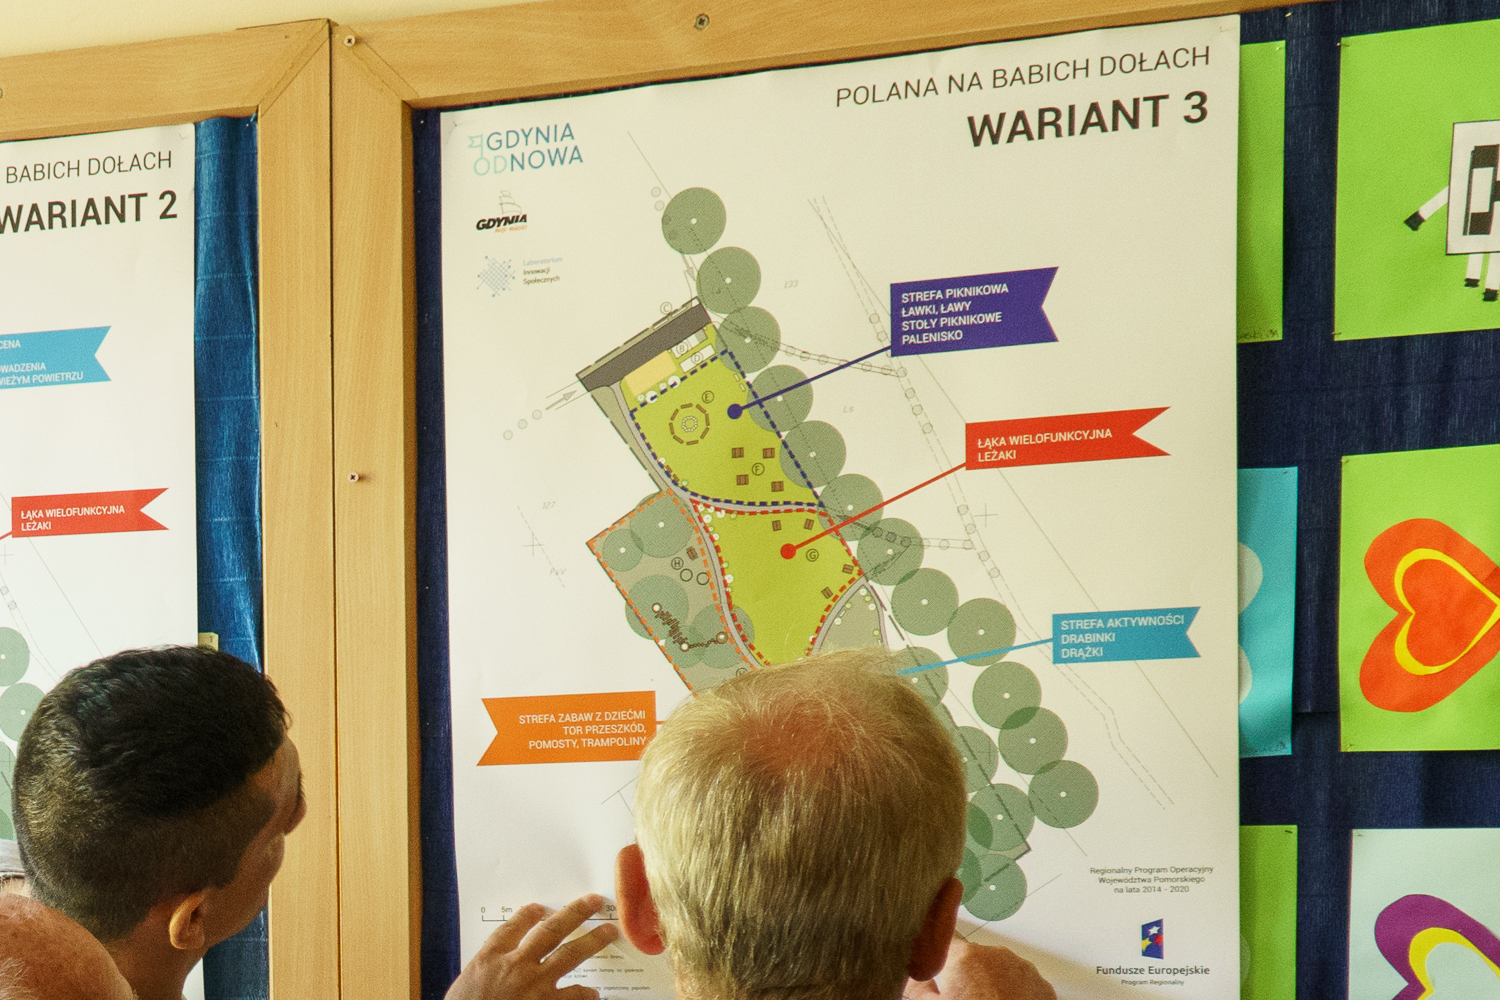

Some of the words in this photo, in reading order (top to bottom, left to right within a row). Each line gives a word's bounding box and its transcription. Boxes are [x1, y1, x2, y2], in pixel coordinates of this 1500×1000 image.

[836, 77, 939, 107] POLANA
[949, 71, 983, 94] NA
[992, 58, 1090, 89] BABICH
[1100, 45, 1211, 77] DOŁACH
[967, 93, 1170, 148] WARIANT
[1183, 90, 1209, 124] 3
[486, 122, 575, 151] GDYNIA
[6, 159, 80, 184] BABICH
[88, 150, 172, 176] DOŁACH
[473, 145, 583, 176] ODNOWA
[159, 189, 178, 220] 2
[476, 214, 527, 231] GDYNIA
[901, 290, 943, 303] STREFA
[945, 283, 1009, 299] PIKNIKOWA
[901, 304, 939, 318] ŁAWKI,
[940, 301, 972, 314] ŁAWY
[901, 318, 937, 331] STOŁY
[940, 311, 1003, 328] PIKNIKOWE
[902, 329, 963, 345] PALENISKO
[32, 371, 84, 384] POWIETRZU
[977, 437, 1007, 449] ŁĄKA
[1008, 428, 1113, 446] WIELOFUNKCYJNA
[977, 449, 1017, 462] LEŻAKI
[20, 510, 44, 521] ŁĄKA
[45, 505, 125, 518] WIELOFUNKCYJNA
[21, 521, 52, 532] LEŻAKI
[1060, 619, 1104, 631] STREFA
[1106, 613, 1185, 629] AKTYWNOŚCI
[1061, 632, 1116, 645] DRABINKI
[1061, 645, 1103, 660] DRĄŻKI
[519, 714, 556, 725] STREFA
[558, 712, 593, 723] ZABAW
[595, 712, 602, 722] Z
[604, 708, 646, 721] DZIEĆMI
[562, 725, 583, 735] TOR
[585, 722, 647, 735] PRZESZKÓD,
[529, 739, 580, 750] POMOSTY,
[581, 736, 647, 747] TRAMPOLINY
[1090, 867, 1132, 876] Regionalny
[1134, 866, 1168, 875] Program
[1169, 866, 1214, 874] Operacyjny
[1098, 876, 1151, 885] Województwa
[1153, 875, 1206, 884] Pomorskiego
[1142, 885, 1162, 893] 2014
[1169, 885, 1190, 893] 2020
[1096, 965, 1146, 975] Fundusze
[1148, 965, 1211, 977] Europejskie
[1121, 979, 1148, 987] Program
